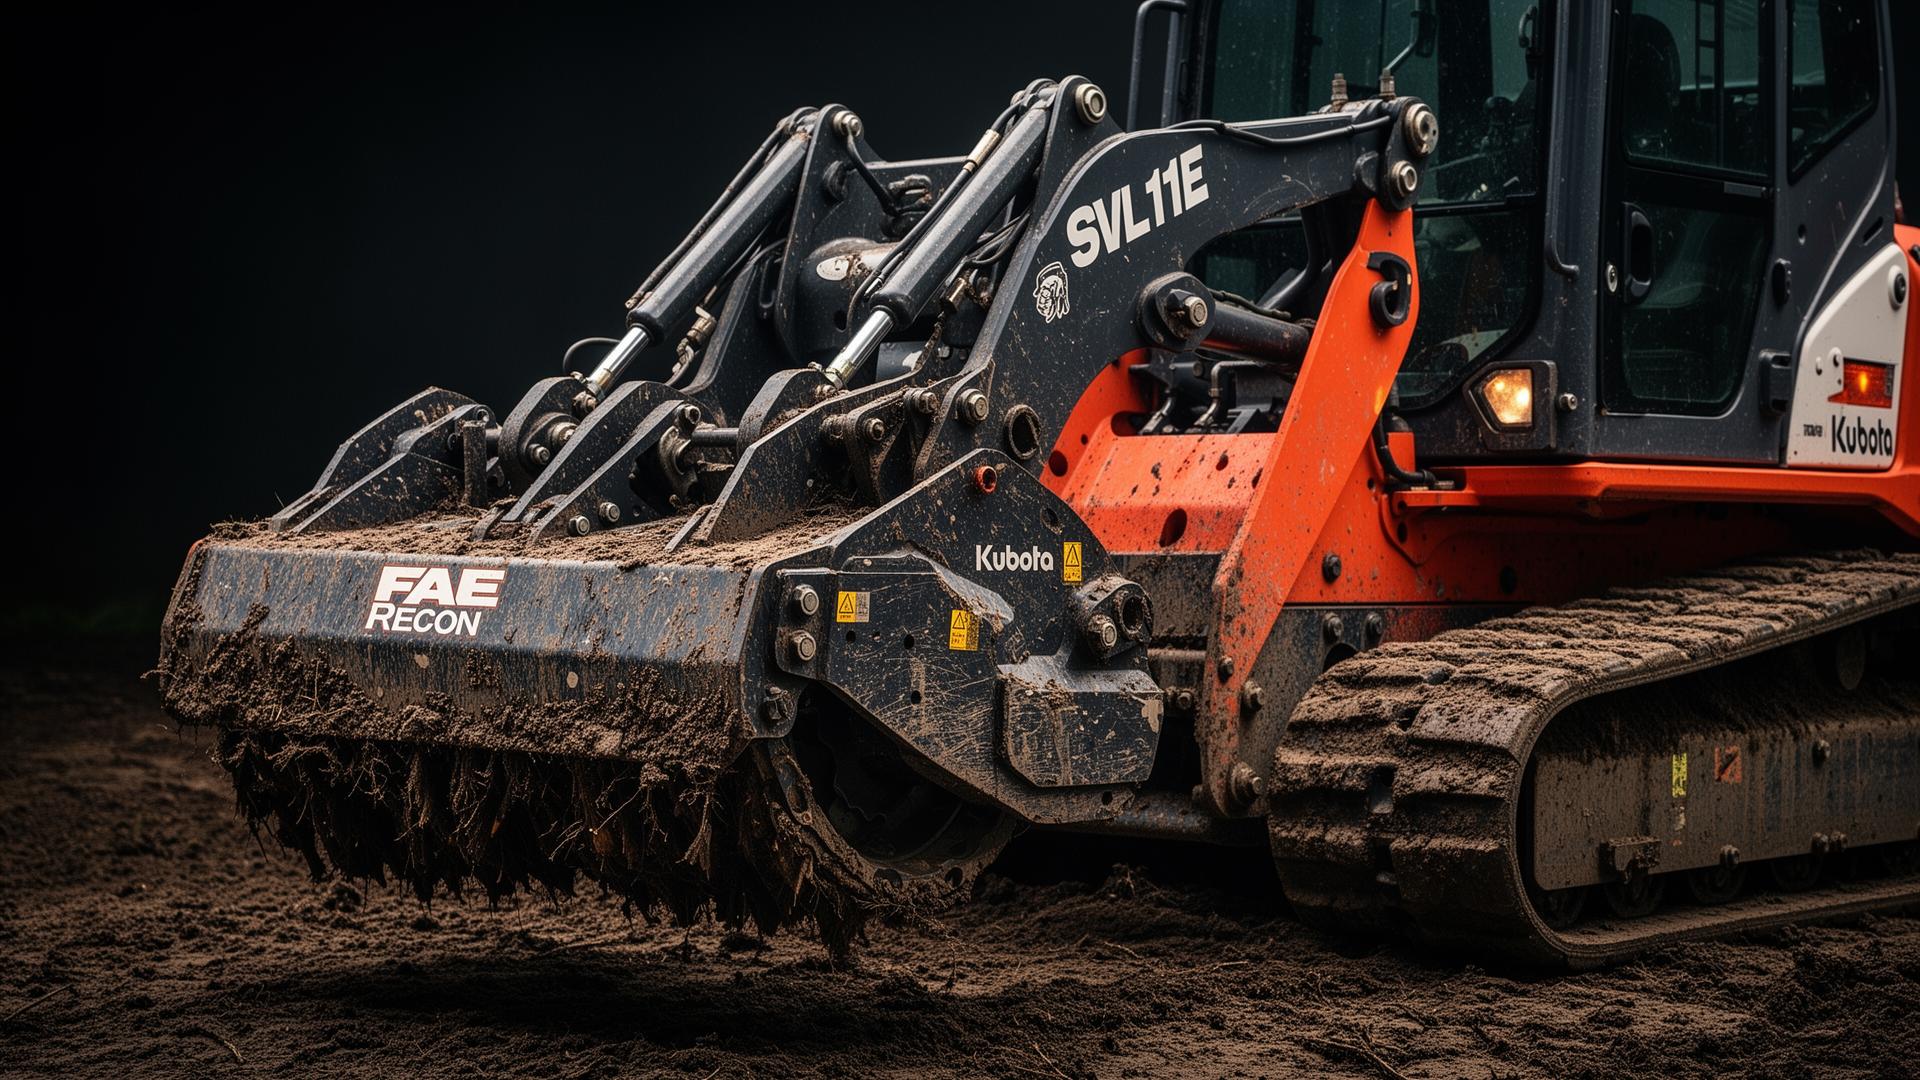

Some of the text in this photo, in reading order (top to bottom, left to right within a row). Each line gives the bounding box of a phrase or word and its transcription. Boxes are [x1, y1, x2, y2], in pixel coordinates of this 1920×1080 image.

[1832, 414, 1893, 456] Kubota
[975, 544, 1054, 572] Kubota
[373, 566, 506, 608] FAE
[365, 602, 482, 636] RECON
